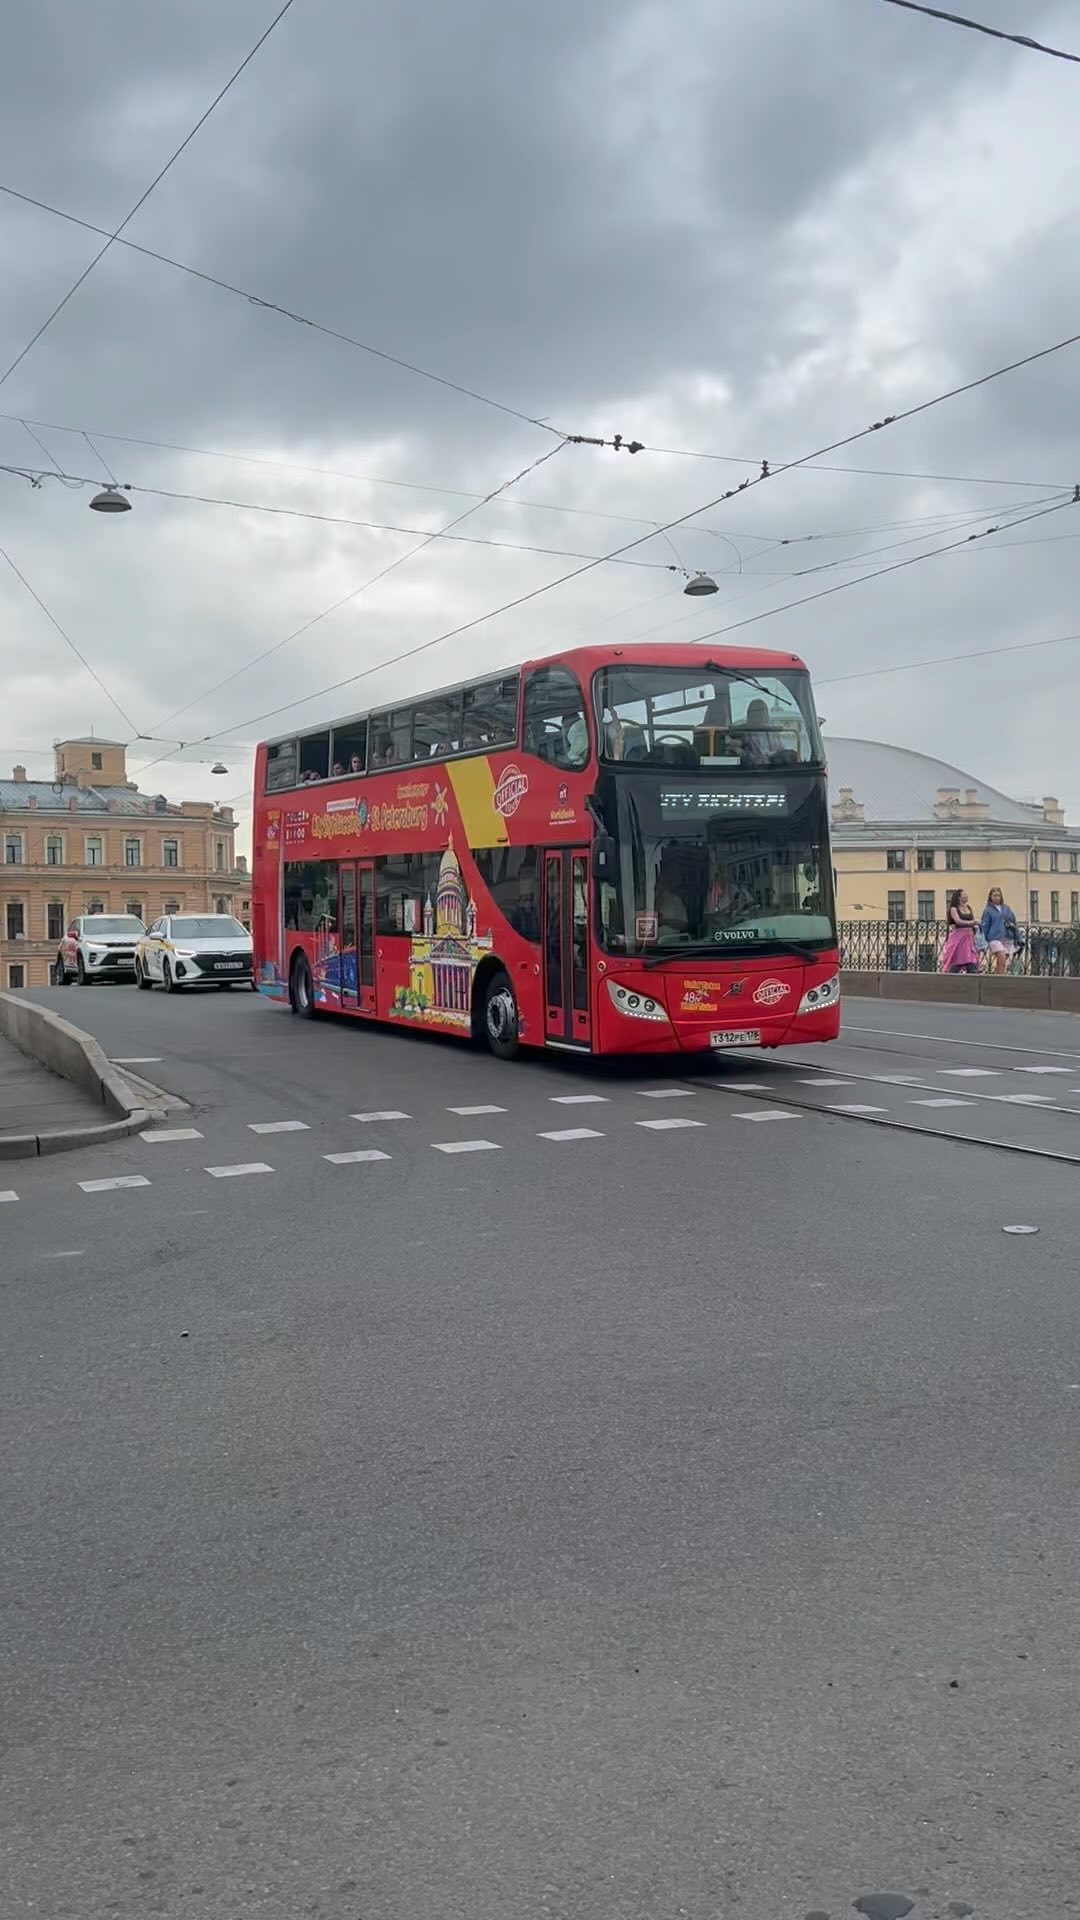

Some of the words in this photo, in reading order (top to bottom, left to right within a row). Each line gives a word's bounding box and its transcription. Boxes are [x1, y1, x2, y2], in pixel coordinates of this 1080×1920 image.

[496, 778, 525, 806] OFFICIAL
[380, 801, 428, 831] Petersburg
[724, 930, 755, 939] VOLVO
[683, 991, 696, 1003] 48
